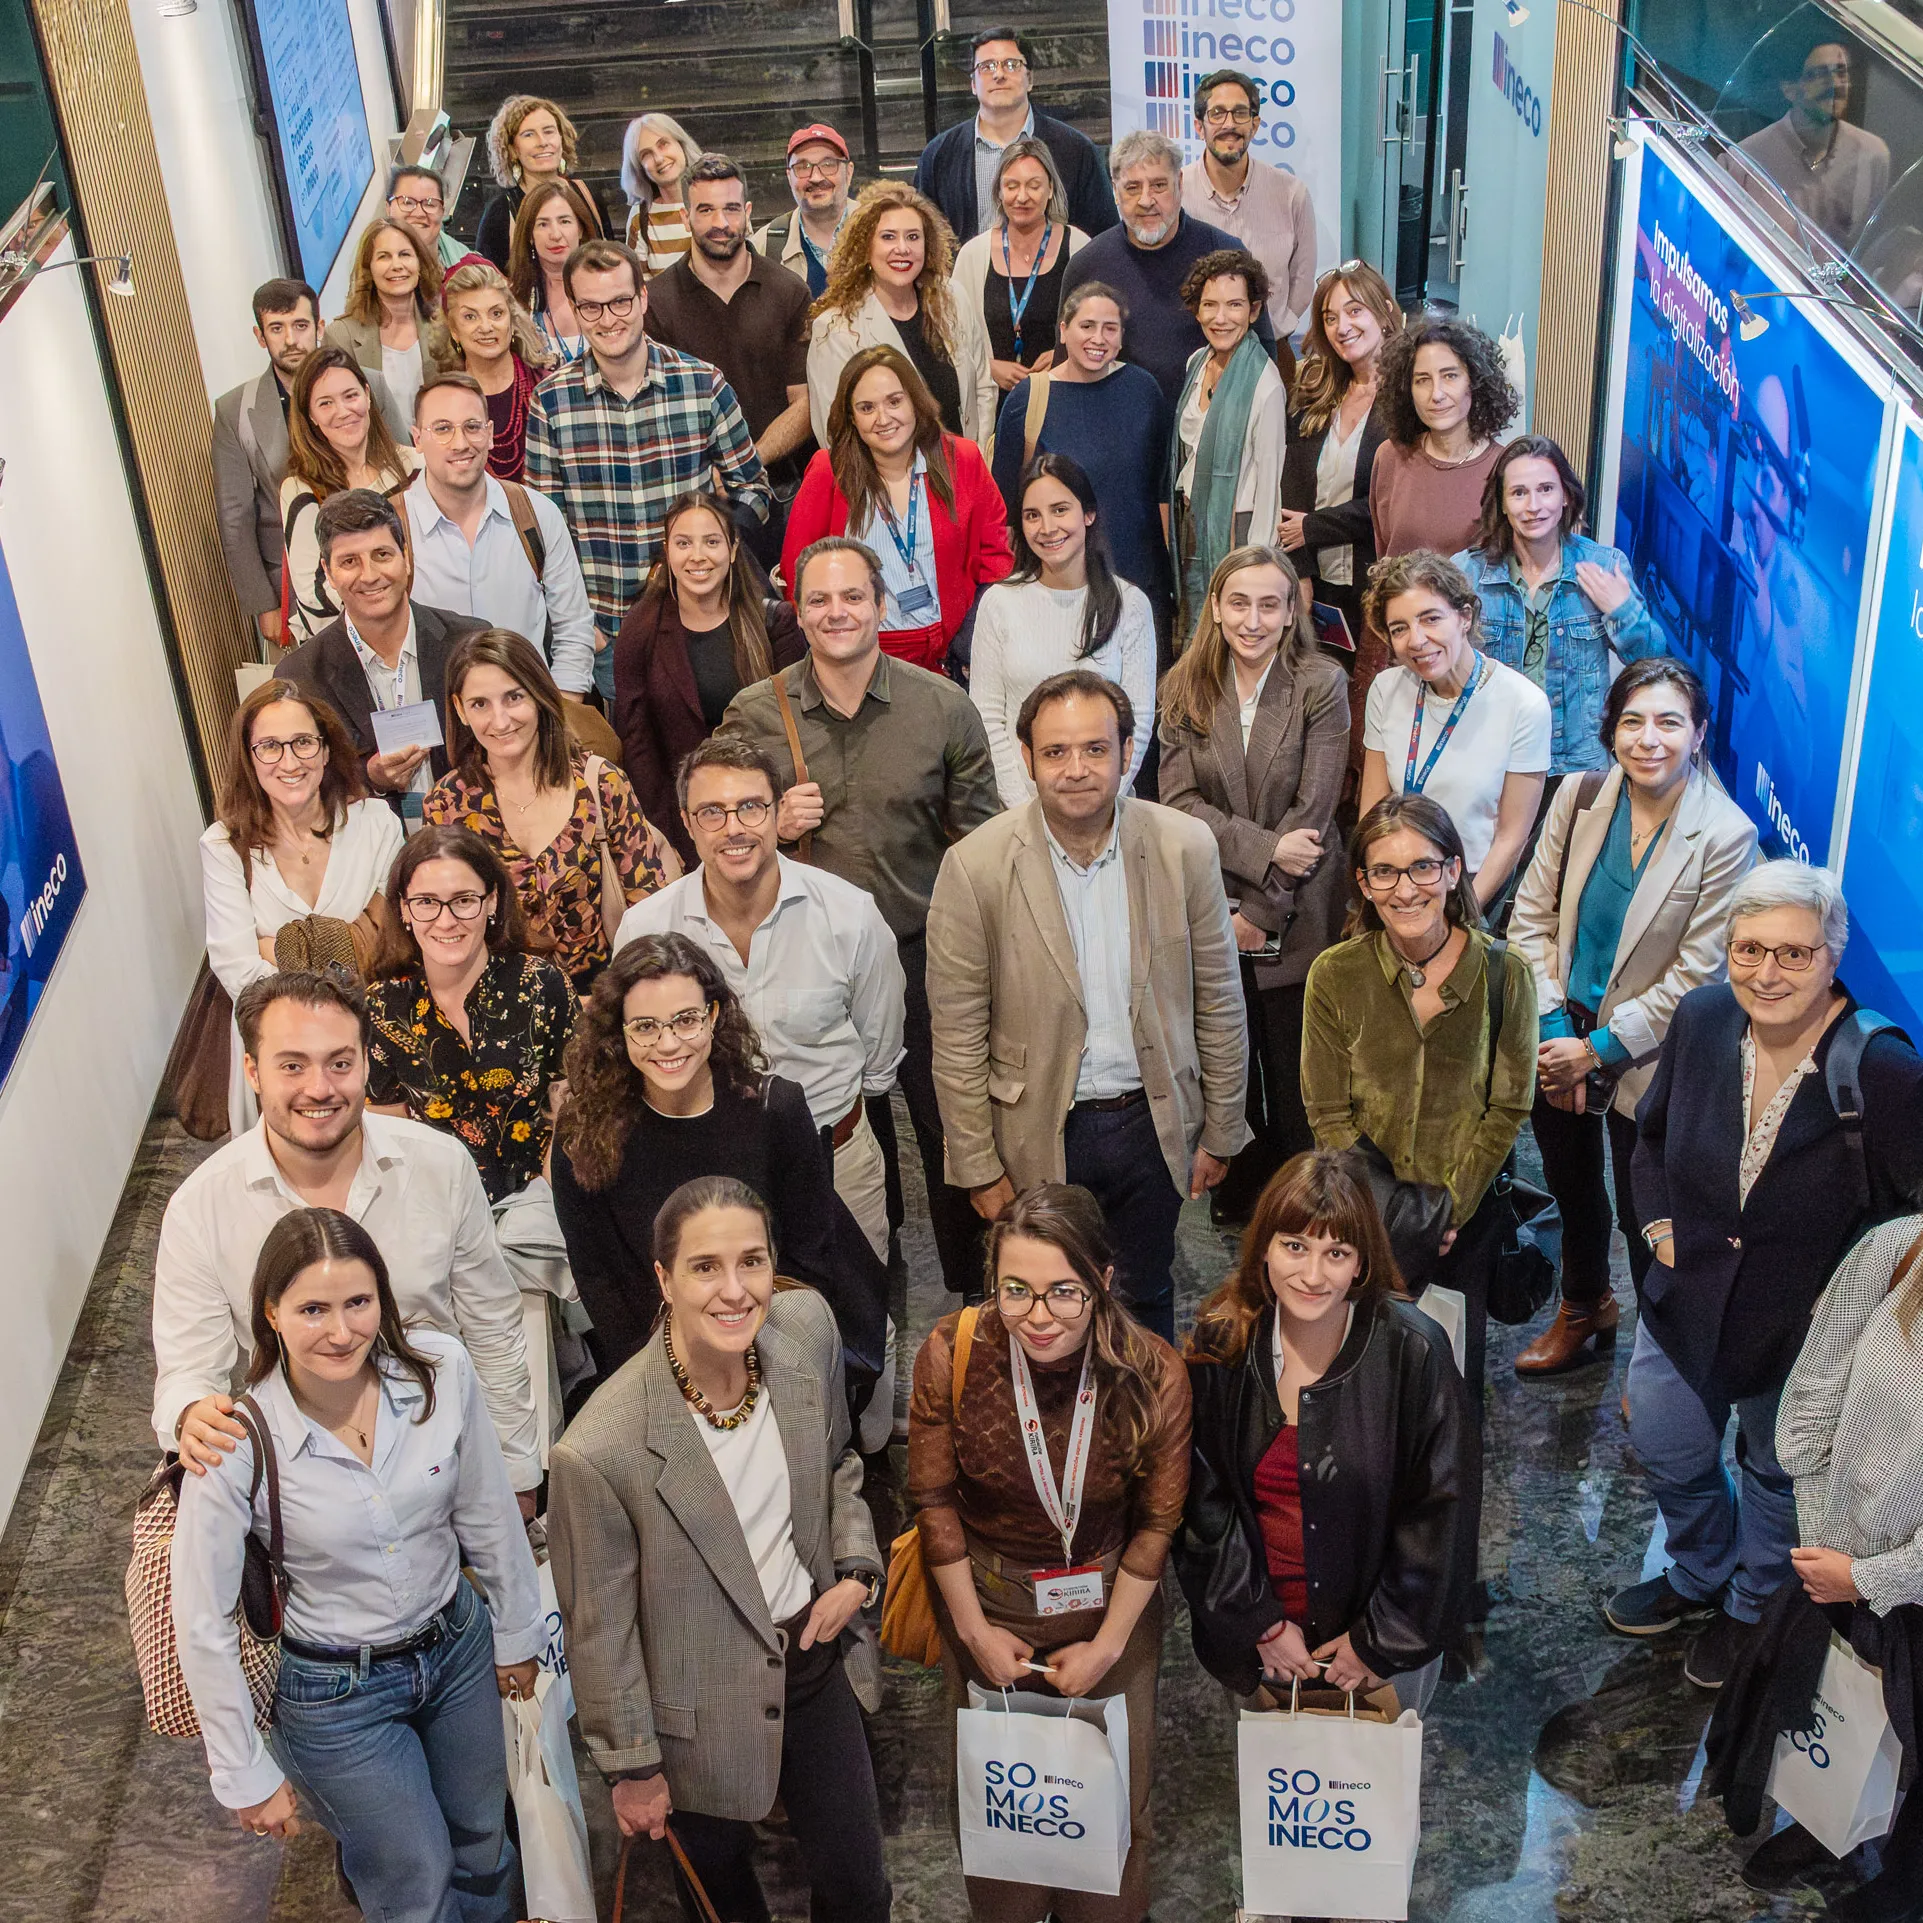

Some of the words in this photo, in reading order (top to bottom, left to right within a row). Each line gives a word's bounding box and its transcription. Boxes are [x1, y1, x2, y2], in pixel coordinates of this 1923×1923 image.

[1182, 21, 1296, 65] ineco
[1503, 43, 1541, 137] ineco
[1653, 219, 1729, 334] Impulsamos
[1649, 267, 1661, 305] la
[1662, 289, 1740, 408] digitalización
[1767, 781, 1810, 866] ineco
[30, 852, 67, 936] ineco
[1028, 1432, 1038, 1456] KIRIRA
[1820, 1698, 1845, 1723] ineco
[985, 1760, 1036, 1789] SO
[1054, 1776, 1084, 1789] ineco
[1268, 1768, 1321, 1795] SO
[1339, 1781, 1371, 1790] ineco
[985, 1785, 1069, 1819] MOS
[1268, 1796, 1355, 1825] MOS
[986, 1807, 1086, 1840] INECO
[1268, 1823, 1372, 1851] INECO
